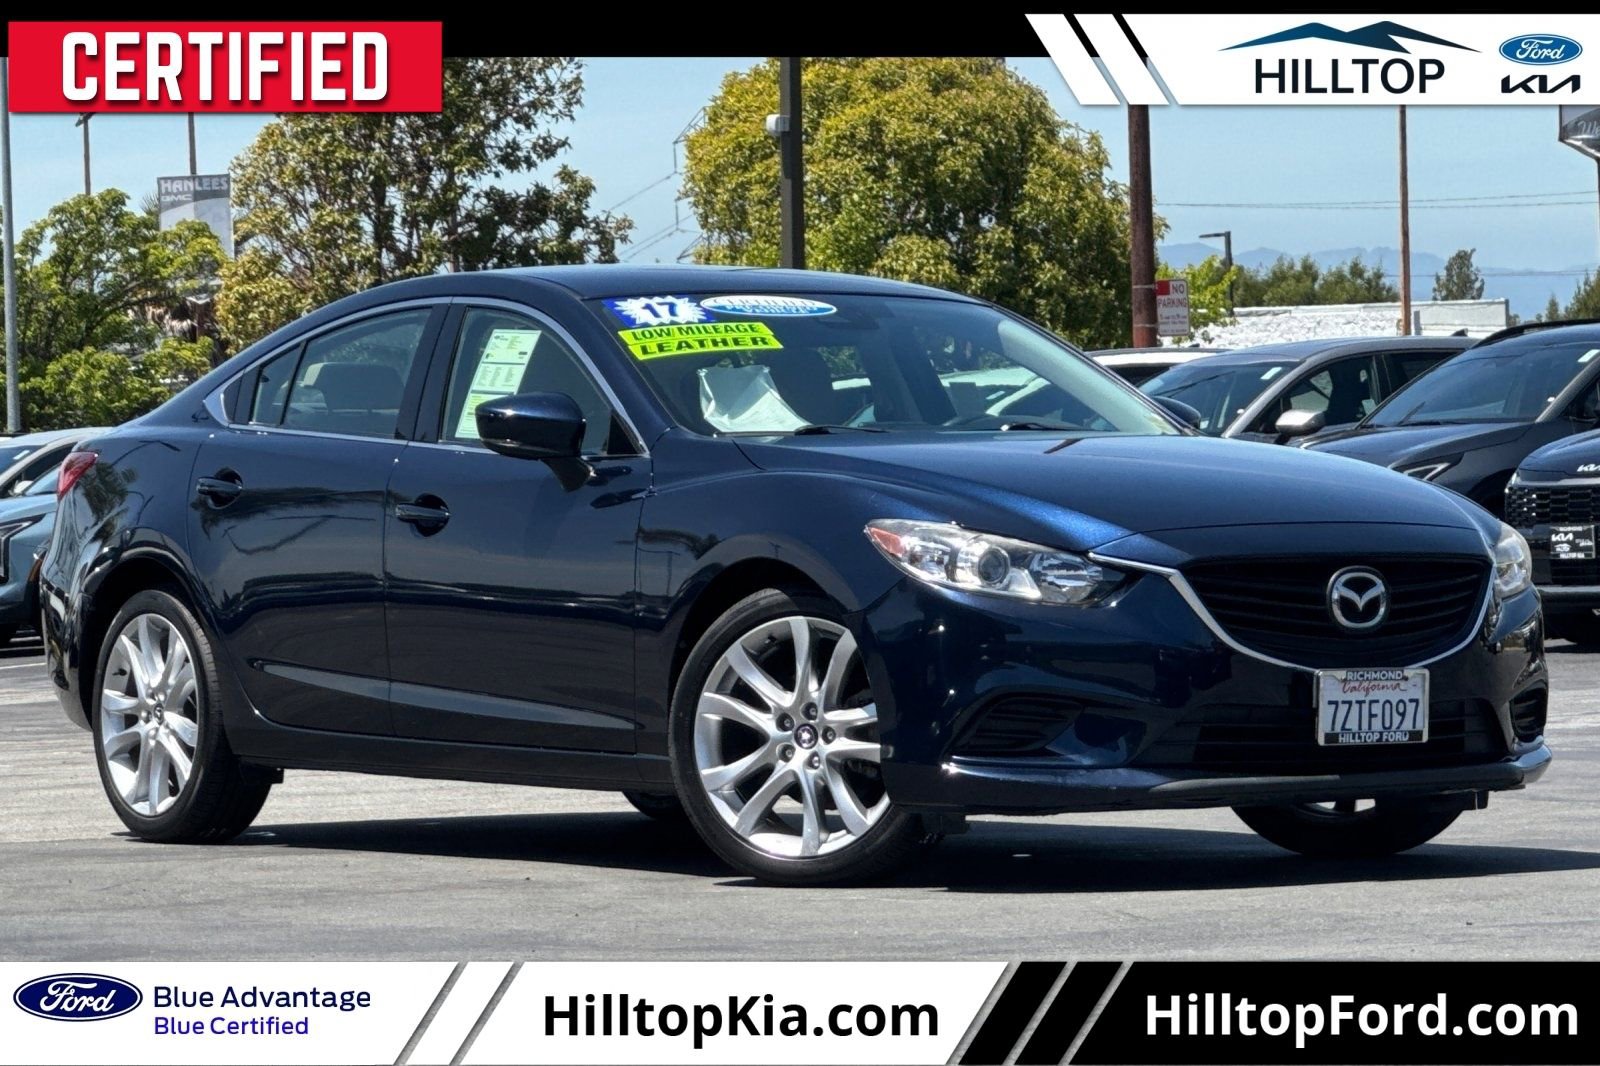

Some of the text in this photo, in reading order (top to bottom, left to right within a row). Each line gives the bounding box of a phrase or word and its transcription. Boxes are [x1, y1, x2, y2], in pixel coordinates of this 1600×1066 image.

[161, 178, 228, 193] HANLEES
[1171, 284, 1184, 294] NO
[642, 301, 678, 318] 17
[631, 323, 761, 341] LOW MILEAGE
[641, 336, 769, 355] LEATHER
[1551, 532, 1574, 541] KIA
[1347, 671, 1403, 680] RICHMOND
[1341, 680, 1408, 697] California
[1327, 698, 1420, 732] 7ZTF097
[1338, 731, 1410, 743] HILLTOP FORD
